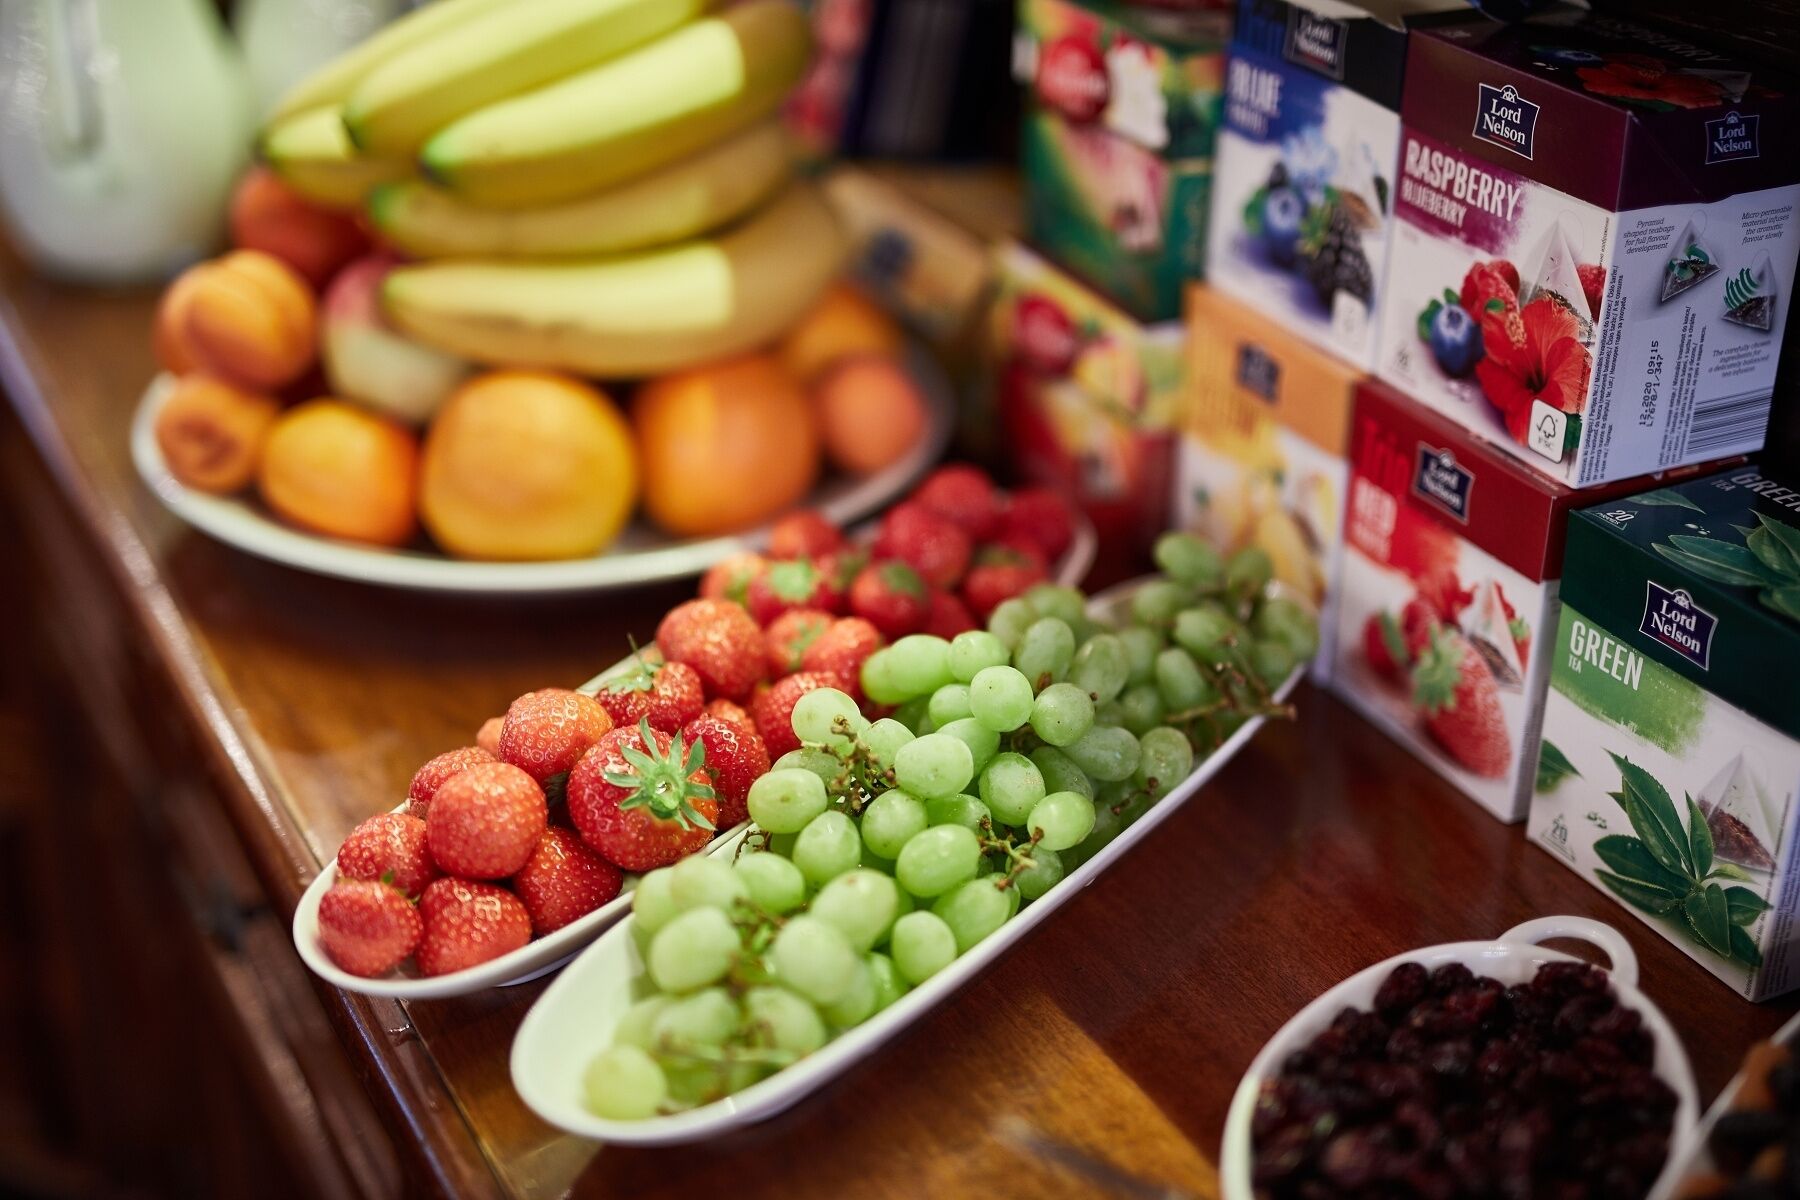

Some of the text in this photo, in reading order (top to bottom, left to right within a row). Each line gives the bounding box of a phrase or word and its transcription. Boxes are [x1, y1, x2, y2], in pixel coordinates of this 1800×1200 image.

[1490, 98, 1522, 124] Lord
[1482, 112, 1526, 145] Nelson
[1718, 123, 1746, 140] Lord
[1713, 139, 1752, 154] Nelson
[1404, 138, 1521, 222] RASPBERRY
[1401, 176, 1467, 229] BLUEBERRY
[1623, 225, 1675, 239] shaped teabags
[1636, 217, 1665, 229] Pyramid
[1745, 228, 1756, 236] the
[1625, 234, 1670, 248] for full flavour
[1626, 242, 1669, 254] development
[1647, 340, 1659, 375] 09:15
[1646, 354, 1664, 427] L7678/1/347
[1710, 479, 1737, 492] TEA
[1606, 509, 1635, 522] 20
[1660, 599, 1697, 632] Lord
[1650, 611, 1701, 654] Nelson
[1568, 653, 1583, 674] TEA
[1569, 620, 1644, 691] GREEN
